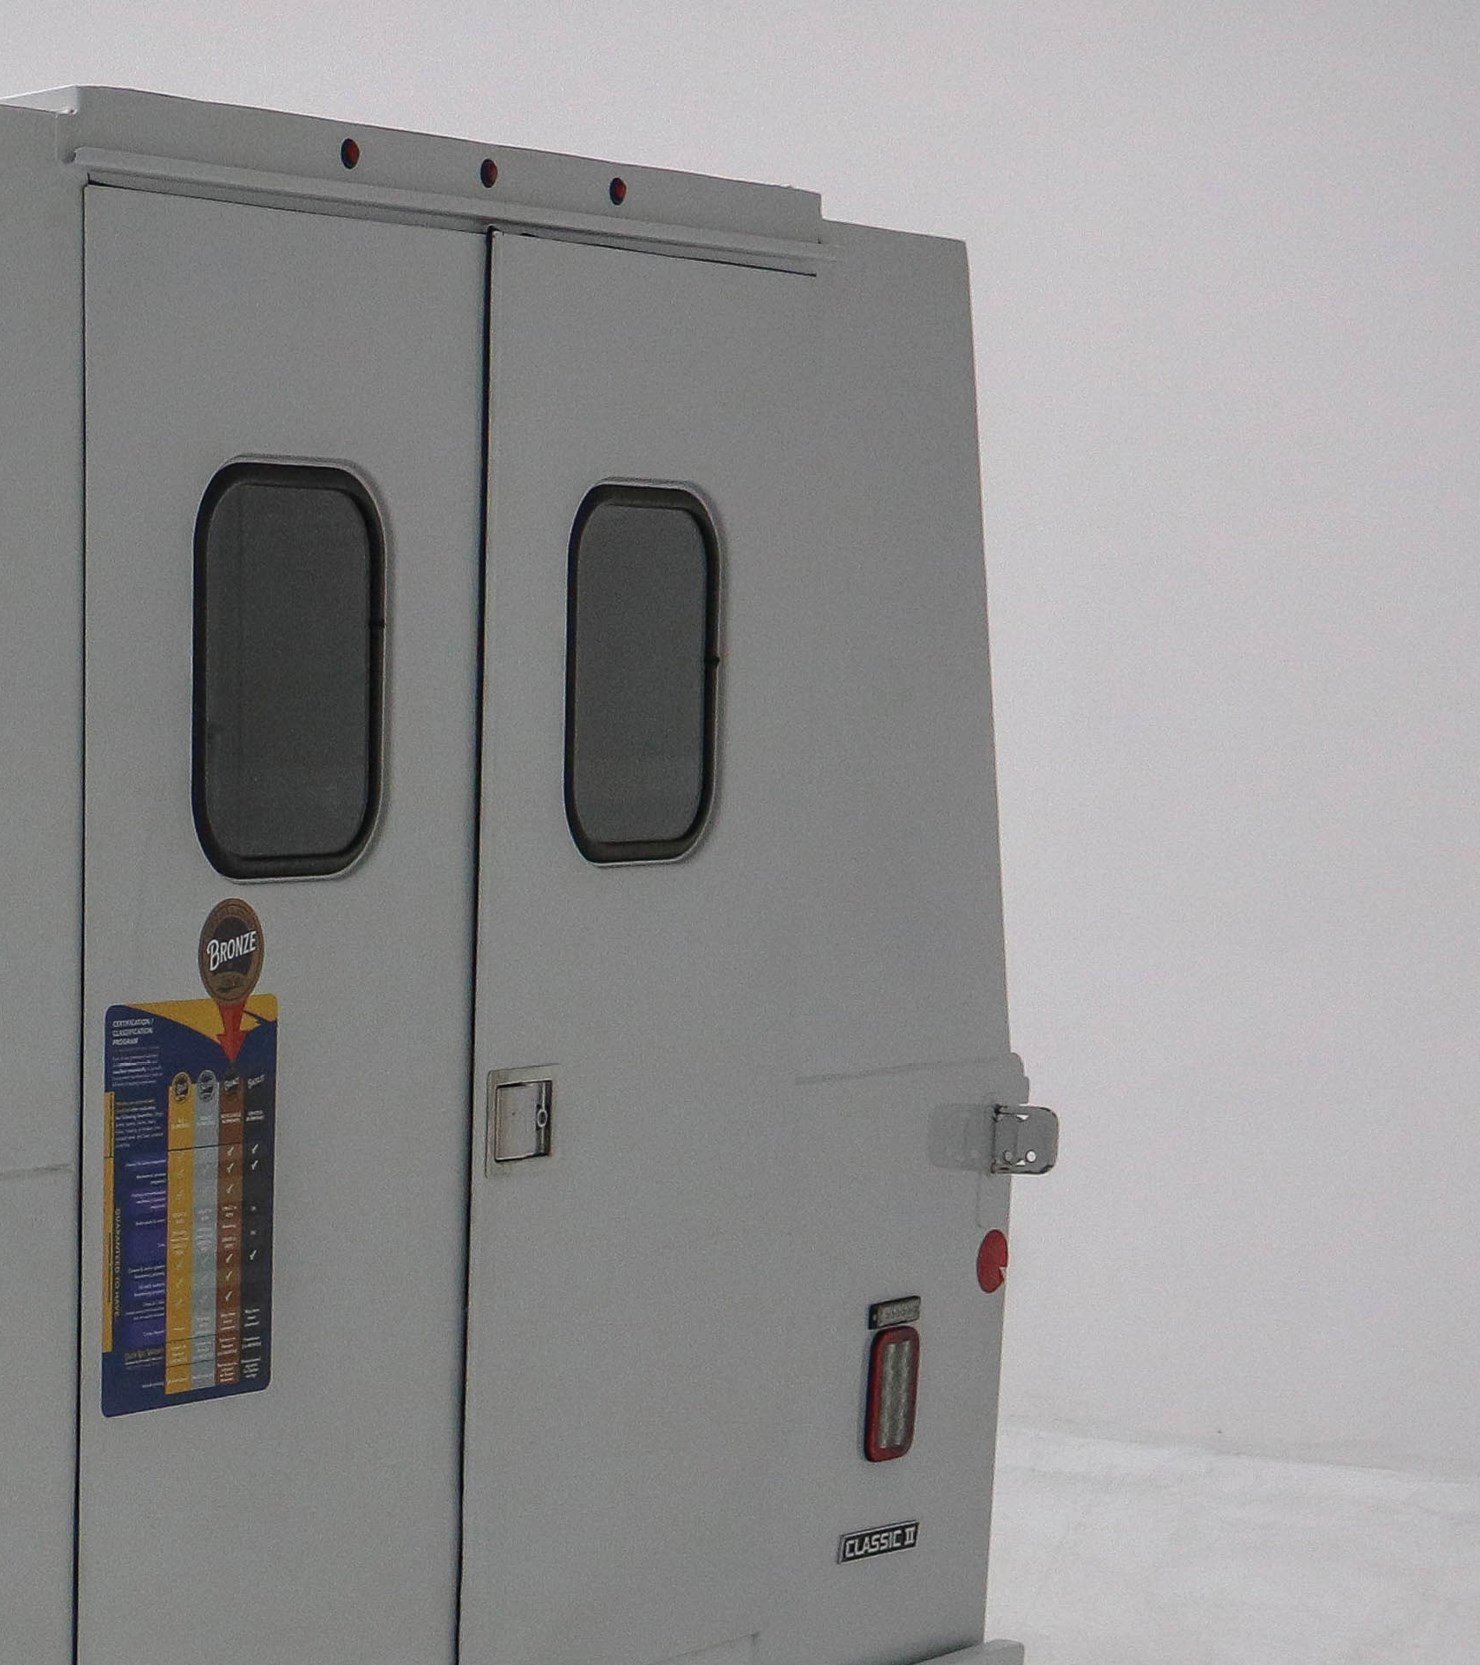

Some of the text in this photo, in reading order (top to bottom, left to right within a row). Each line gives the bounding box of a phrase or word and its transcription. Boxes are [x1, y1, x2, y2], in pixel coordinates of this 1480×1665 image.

[206, 931, 257, 972] BRONZE
[845, 1525, 916, 1558] CLASSIC II
